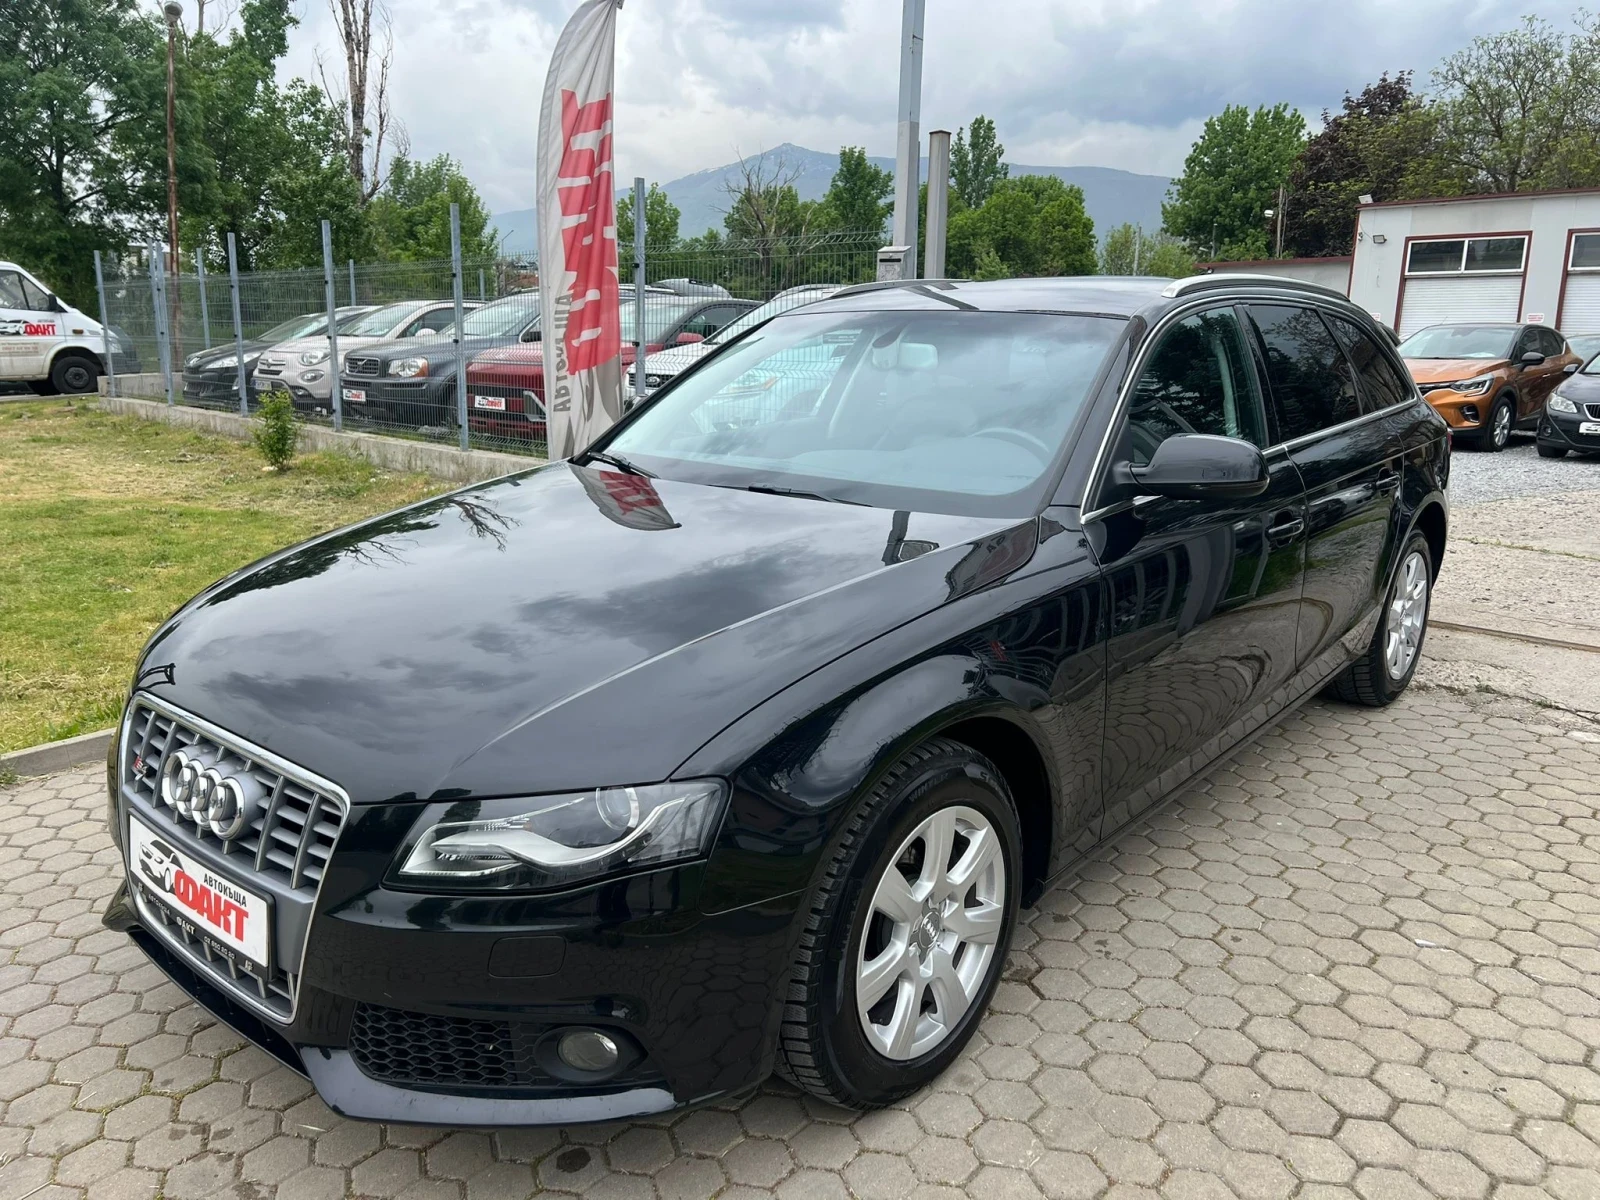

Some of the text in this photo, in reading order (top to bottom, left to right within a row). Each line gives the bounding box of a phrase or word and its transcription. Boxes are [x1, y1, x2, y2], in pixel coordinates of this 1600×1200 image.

[25, 324, 56, 336] ФАКТ
[174, 869, 249, 943] ФАКТ
[203, 873, 247, 908] АВТОКЪЩА
